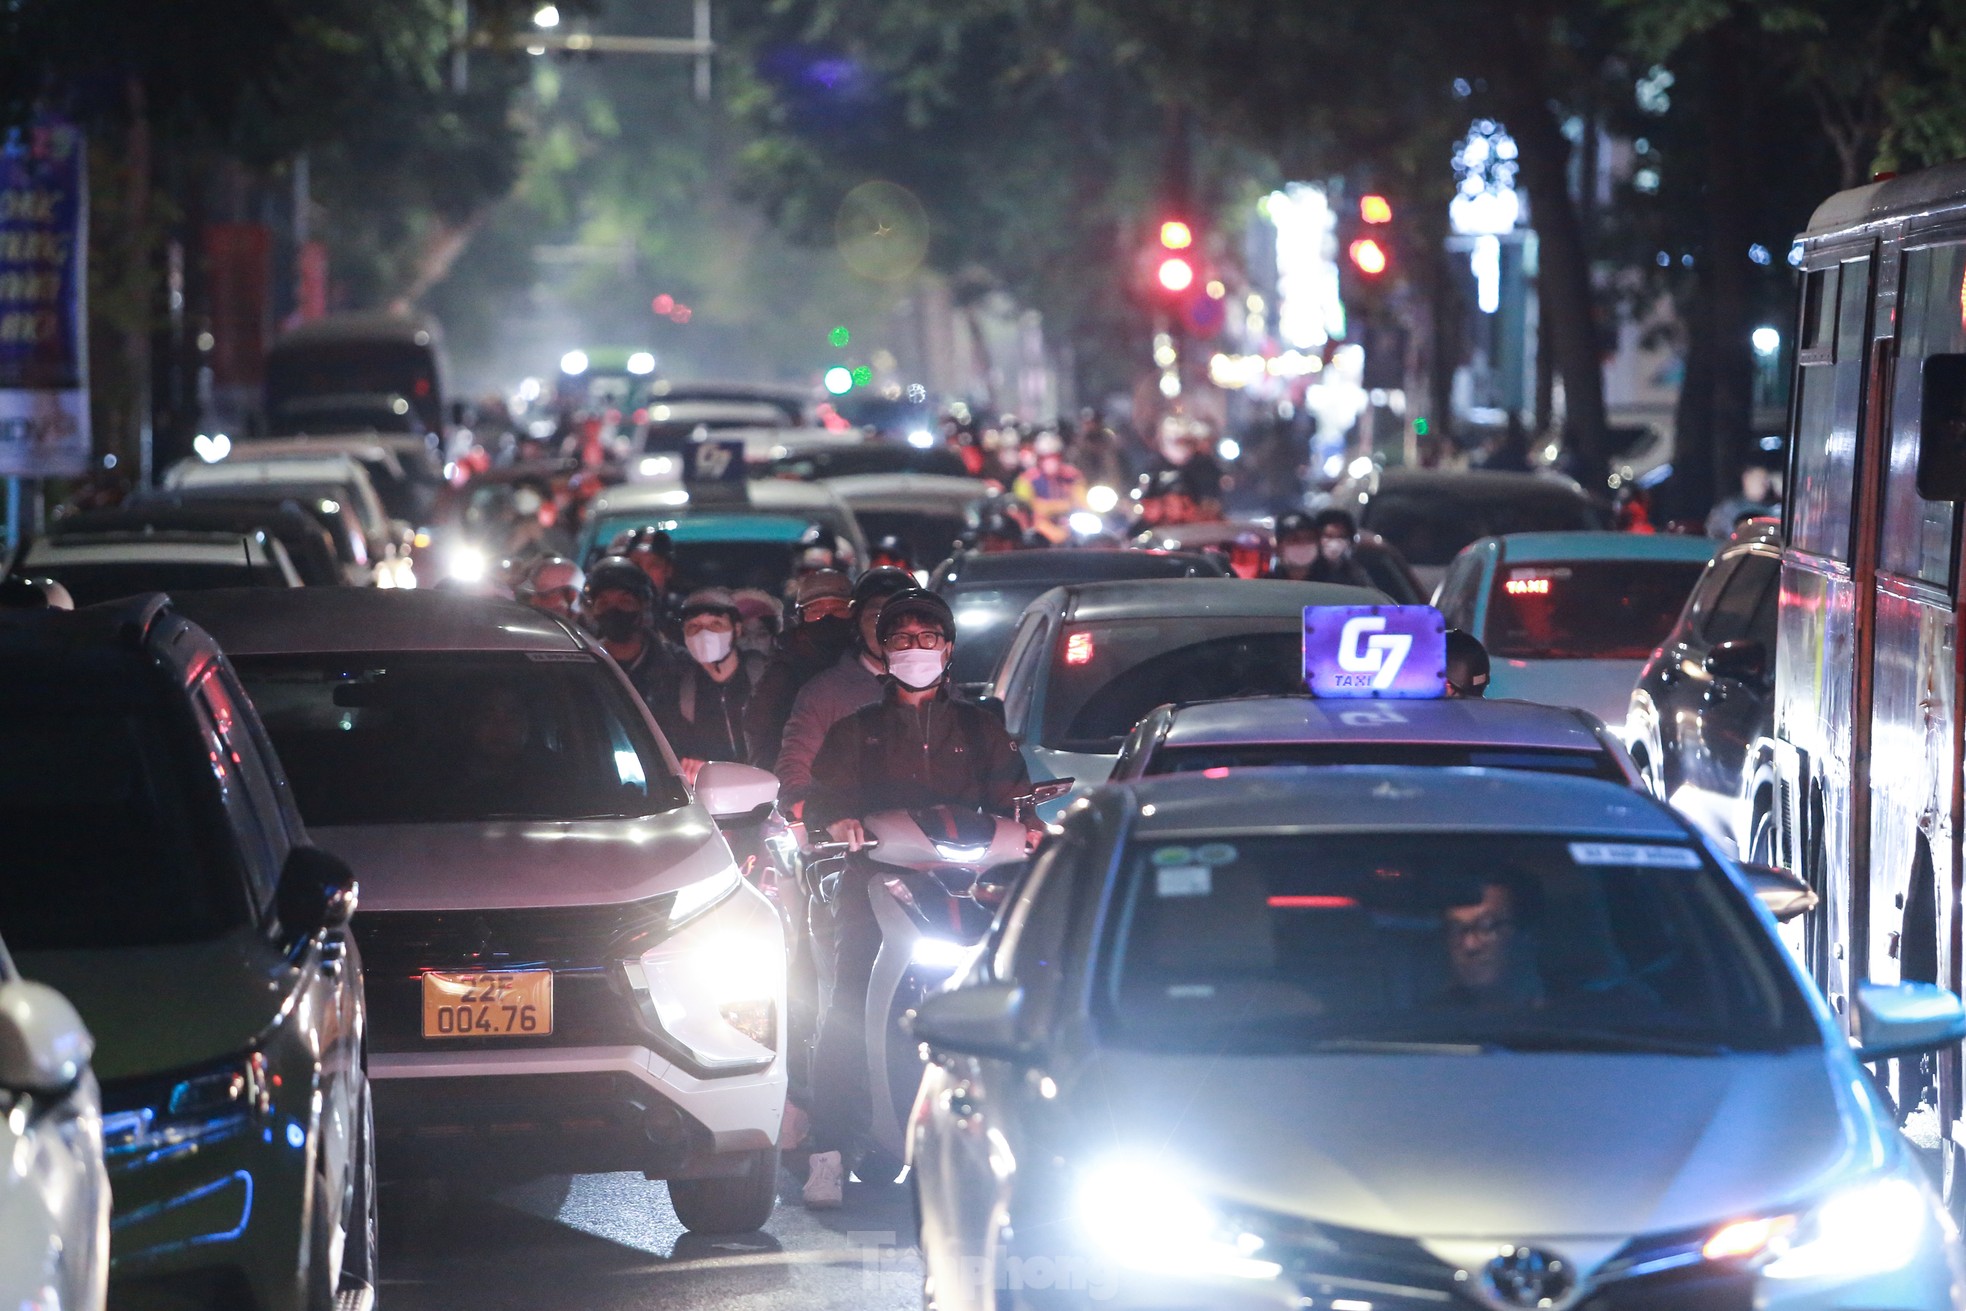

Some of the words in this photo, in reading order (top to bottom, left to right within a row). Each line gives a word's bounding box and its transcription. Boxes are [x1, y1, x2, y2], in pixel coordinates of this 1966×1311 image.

[1338, 616, 1413, 689] G7
[1335, 675, 1371, 687] TAXI
[437, 1005, 536, 1033] 004.76
